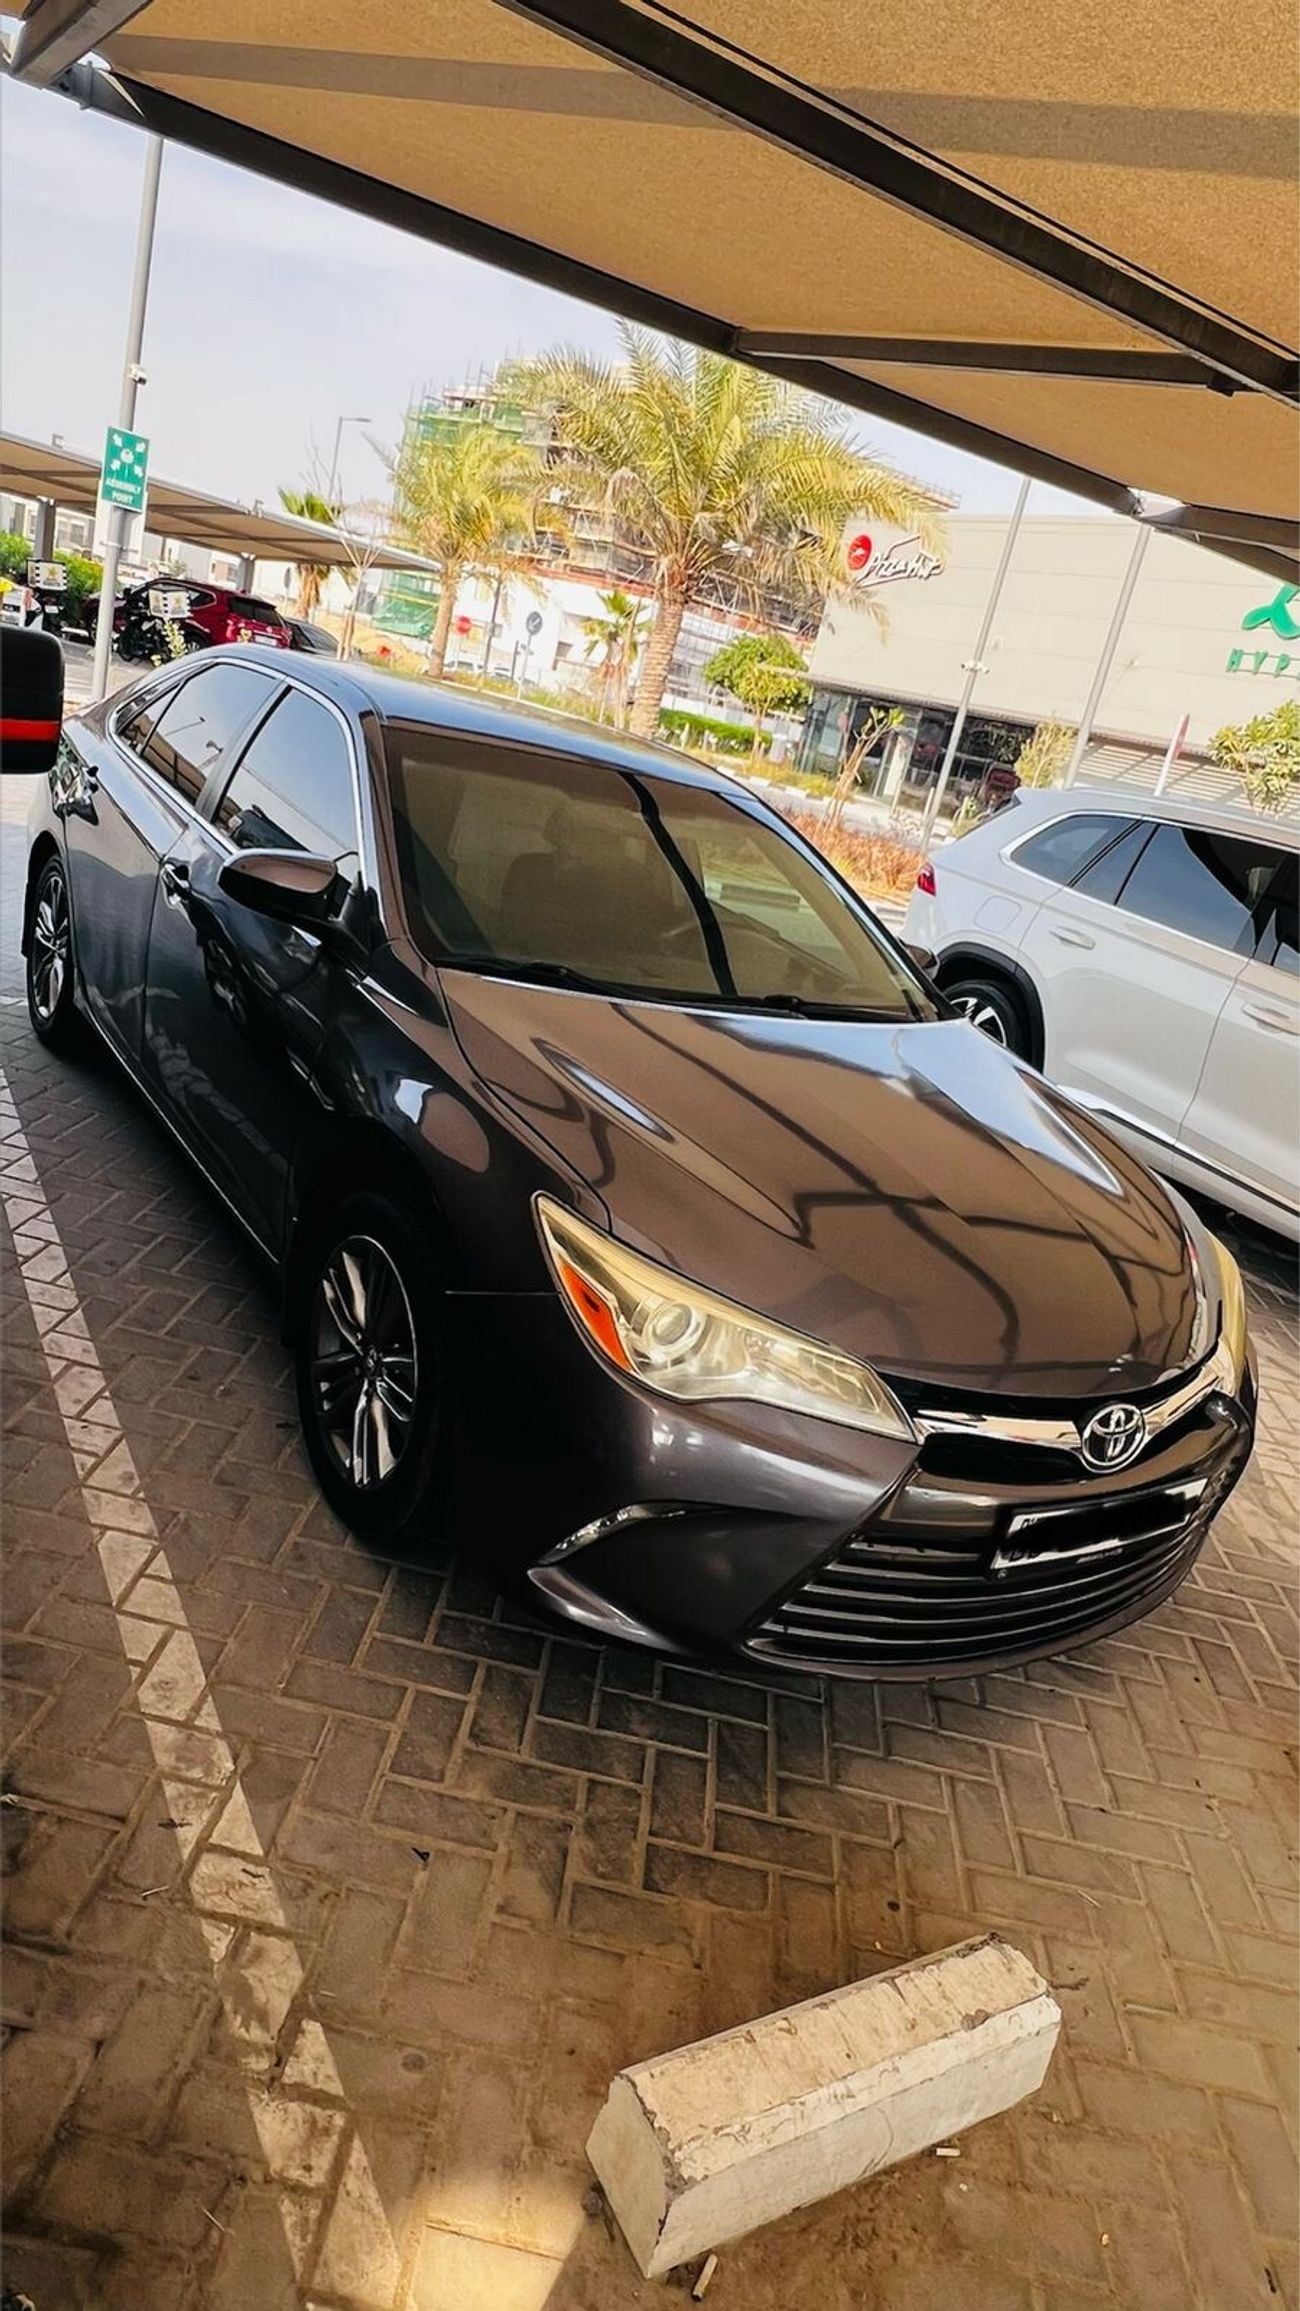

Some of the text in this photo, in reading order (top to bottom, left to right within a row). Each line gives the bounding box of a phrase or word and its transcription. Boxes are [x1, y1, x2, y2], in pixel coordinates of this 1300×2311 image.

[112, 490, 133, 505] POINT
[856, 552, 945, 585] Pizza Hut
[1225, 648, 1299, 680] HYP
